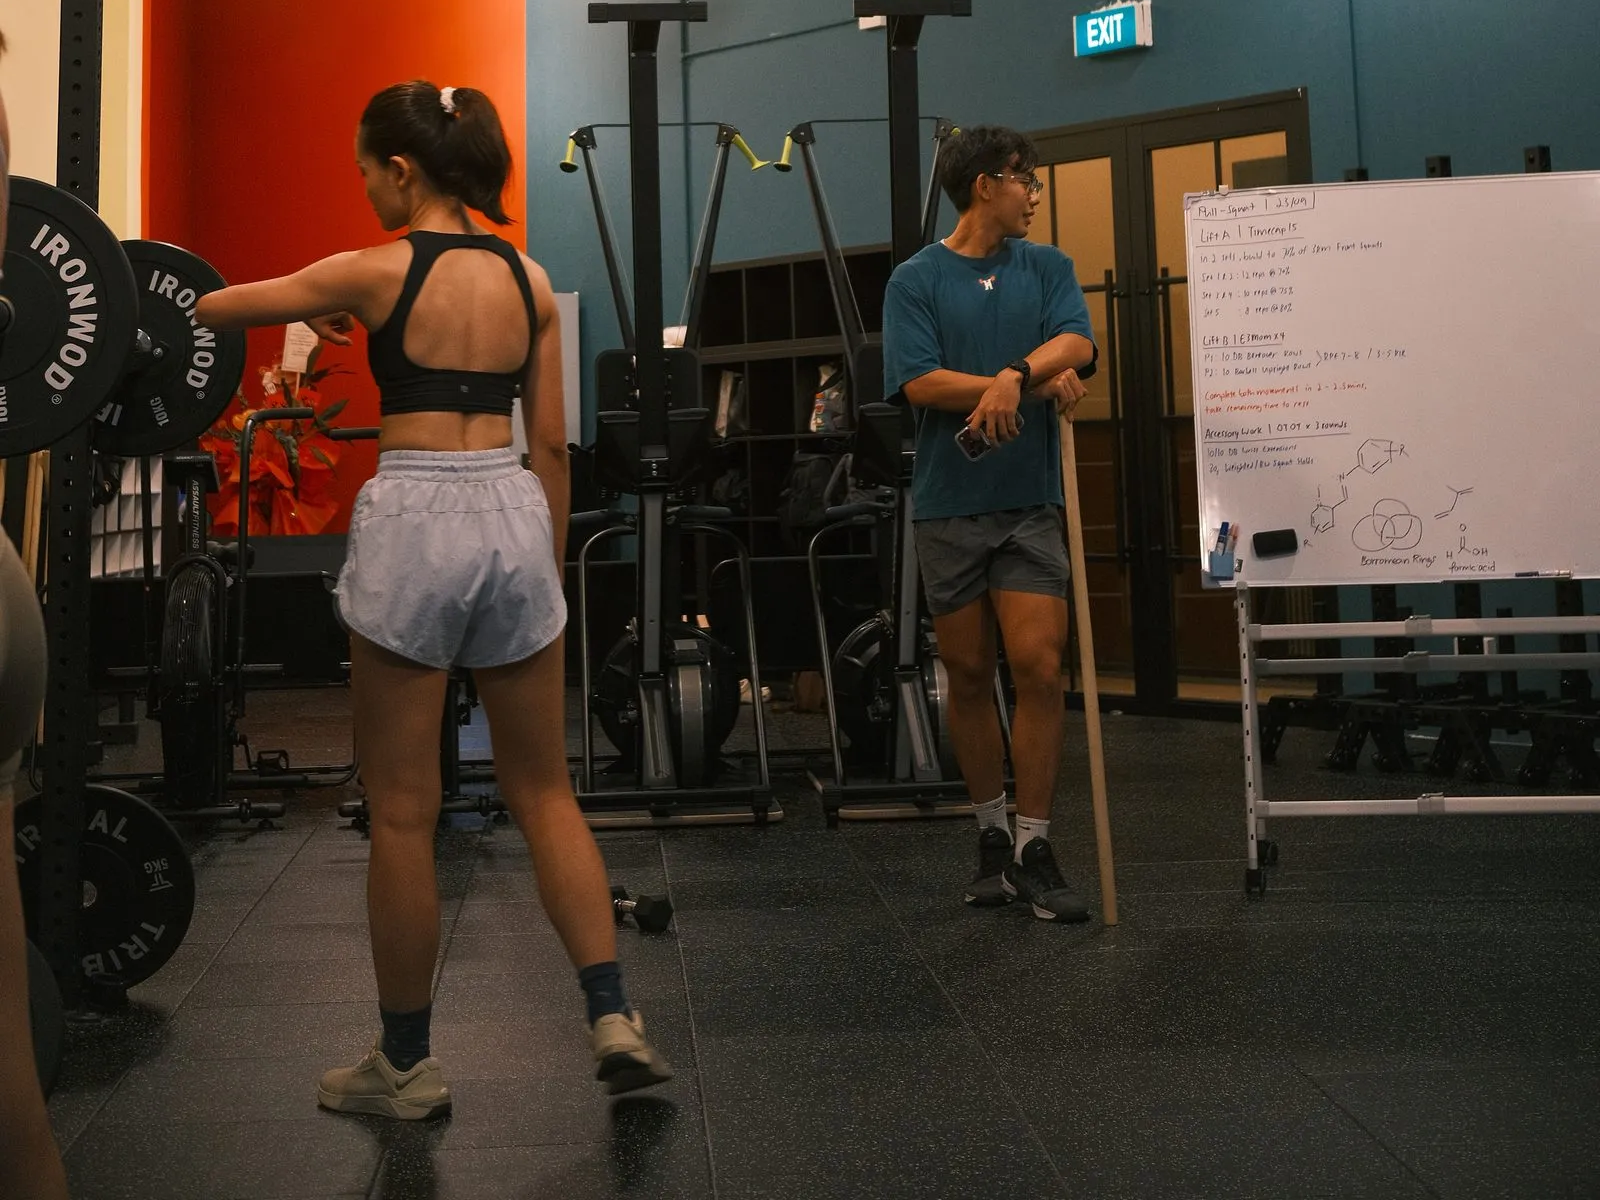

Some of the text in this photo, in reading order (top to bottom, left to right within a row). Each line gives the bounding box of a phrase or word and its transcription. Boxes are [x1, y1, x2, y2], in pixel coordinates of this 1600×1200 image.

[1086, 12, 1124, 48] EXIT
[1200, 227, 1220, 243] Lift
[1222, 228, 1231, 241] A
[30, 223, 98, 392] IRONWOD
[1202, 334, 1220, 346] Lift
[1222, 335, 1229, 346] B
[151, 396, 169, 427] 10KG
[1412, 554, 1438, 568] Rings
[1478, 560, 1497, 572] acid
[143, 857, 169, 875] 5KG
